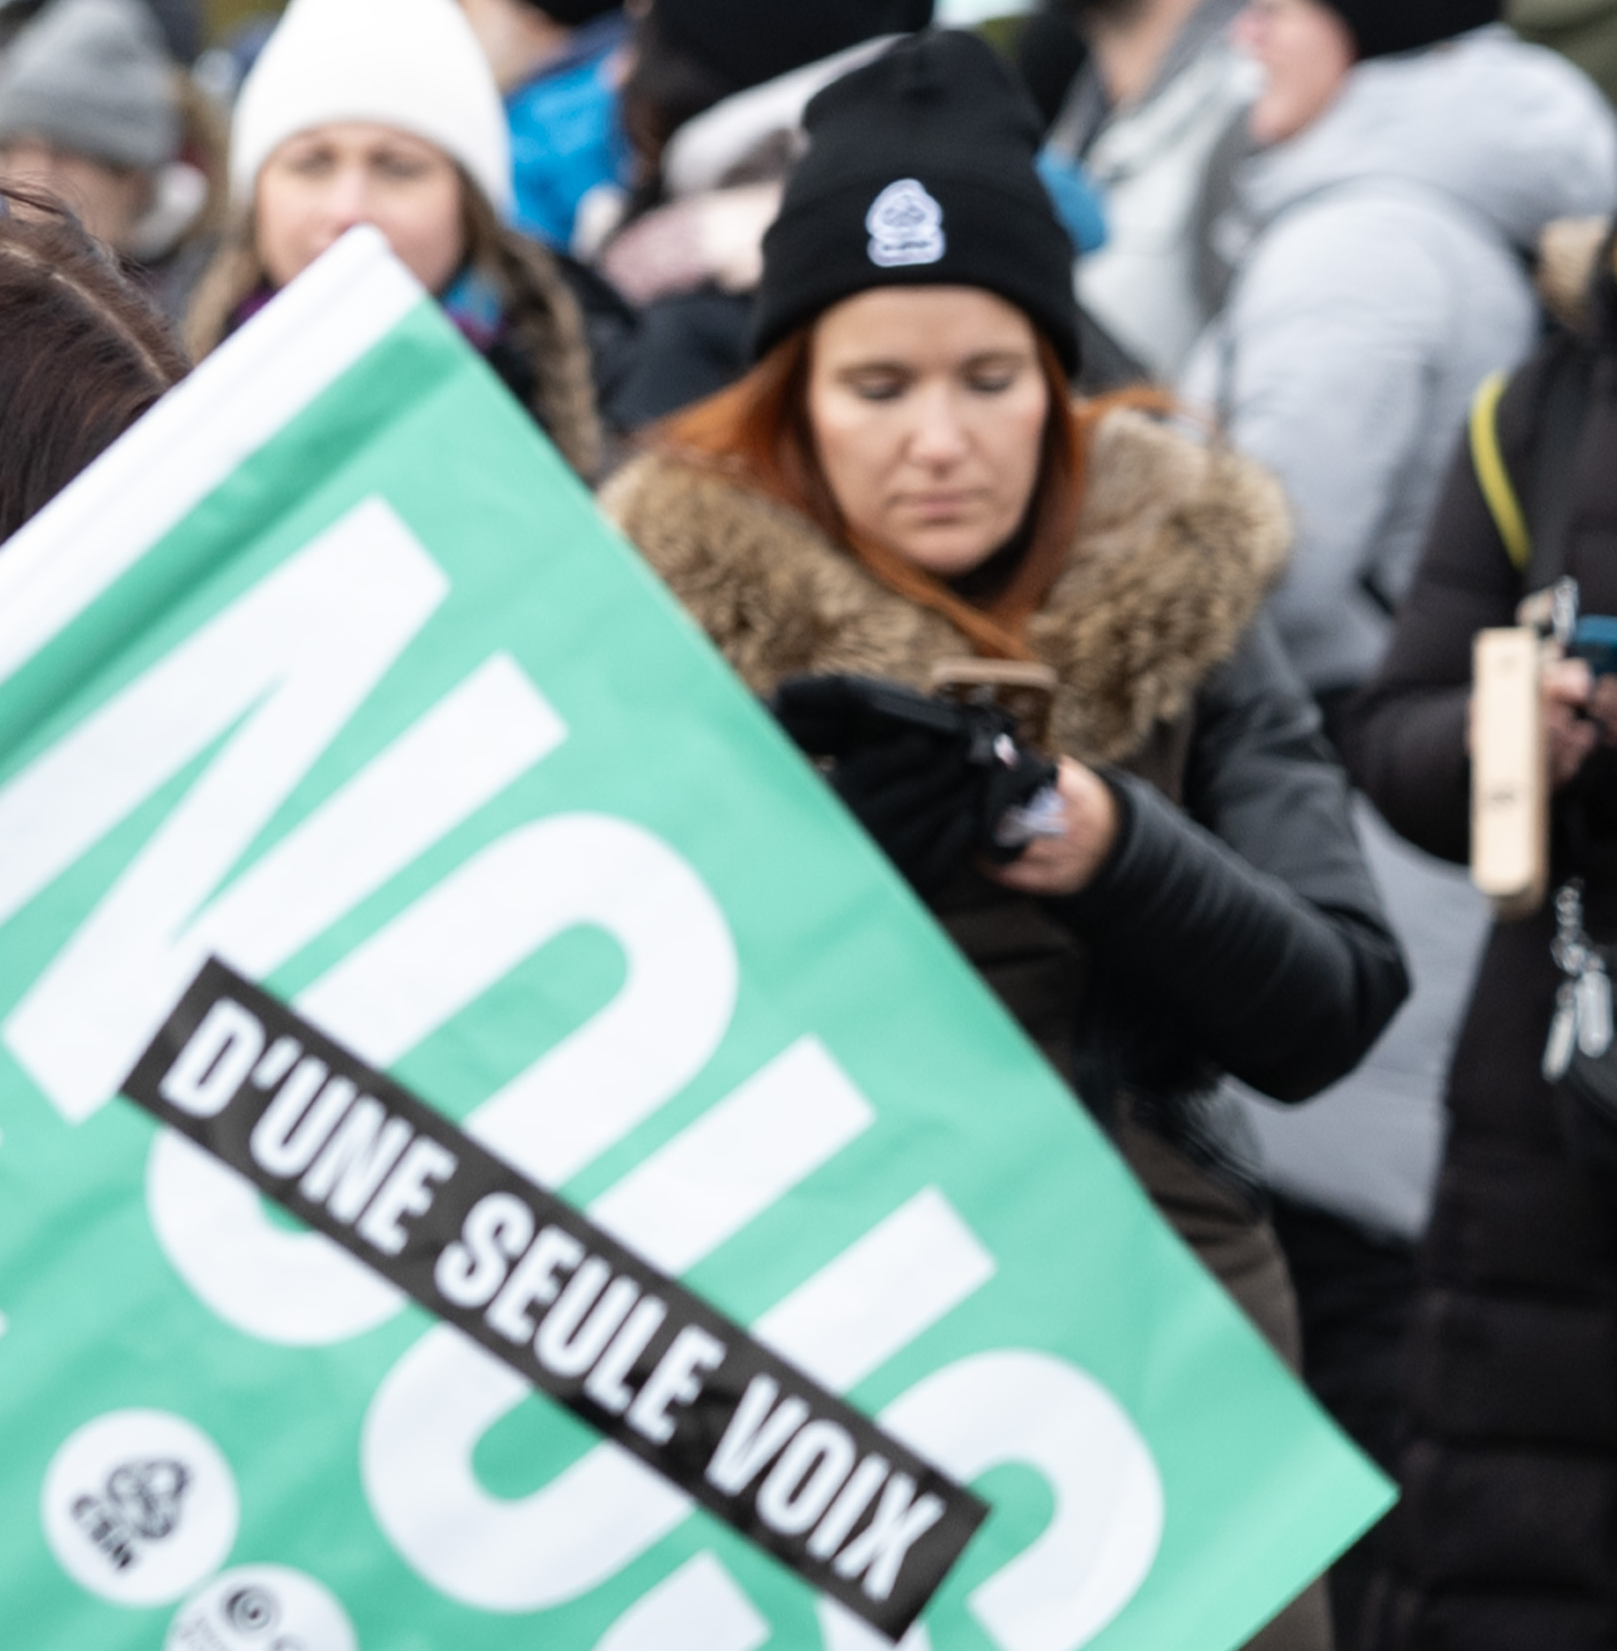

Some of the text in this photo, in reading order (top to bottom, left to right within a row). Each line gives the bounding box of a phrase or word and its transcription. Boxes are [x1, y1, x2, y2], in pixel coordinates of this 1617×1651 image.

[157, 995, 947, 1602] D'UNE SEULE VOIX
